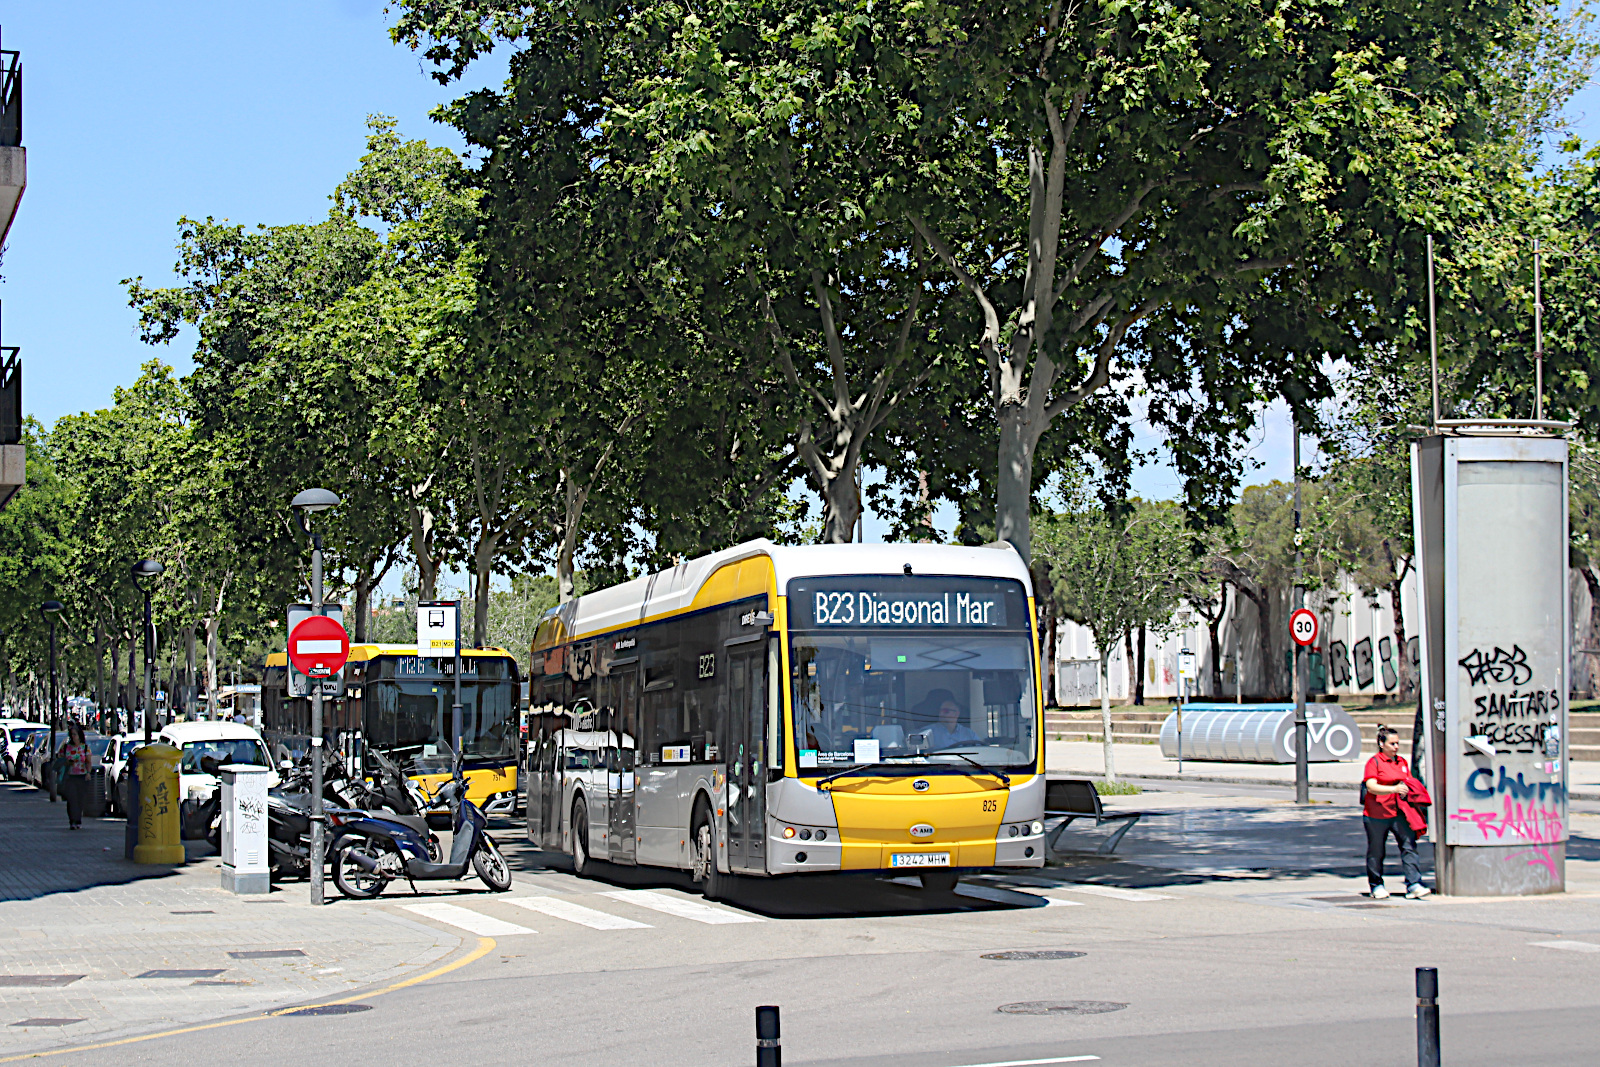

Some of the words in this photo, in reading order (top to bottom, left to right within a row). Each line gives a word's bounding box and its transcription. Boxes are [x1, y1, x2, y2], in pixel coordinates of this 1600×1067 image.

[816, 592, 855, 624] B23
[859, 592, 949, 624] Diagonal
[956, 592, 994, 624] Mar
[1296, 621, 1312, 633] 30
[699, 653, 715, 678] B23
[983, 800, 997, 812] 825
[899, 855, 925, 865] 3242
[927, 854, 947, 863] MHW
